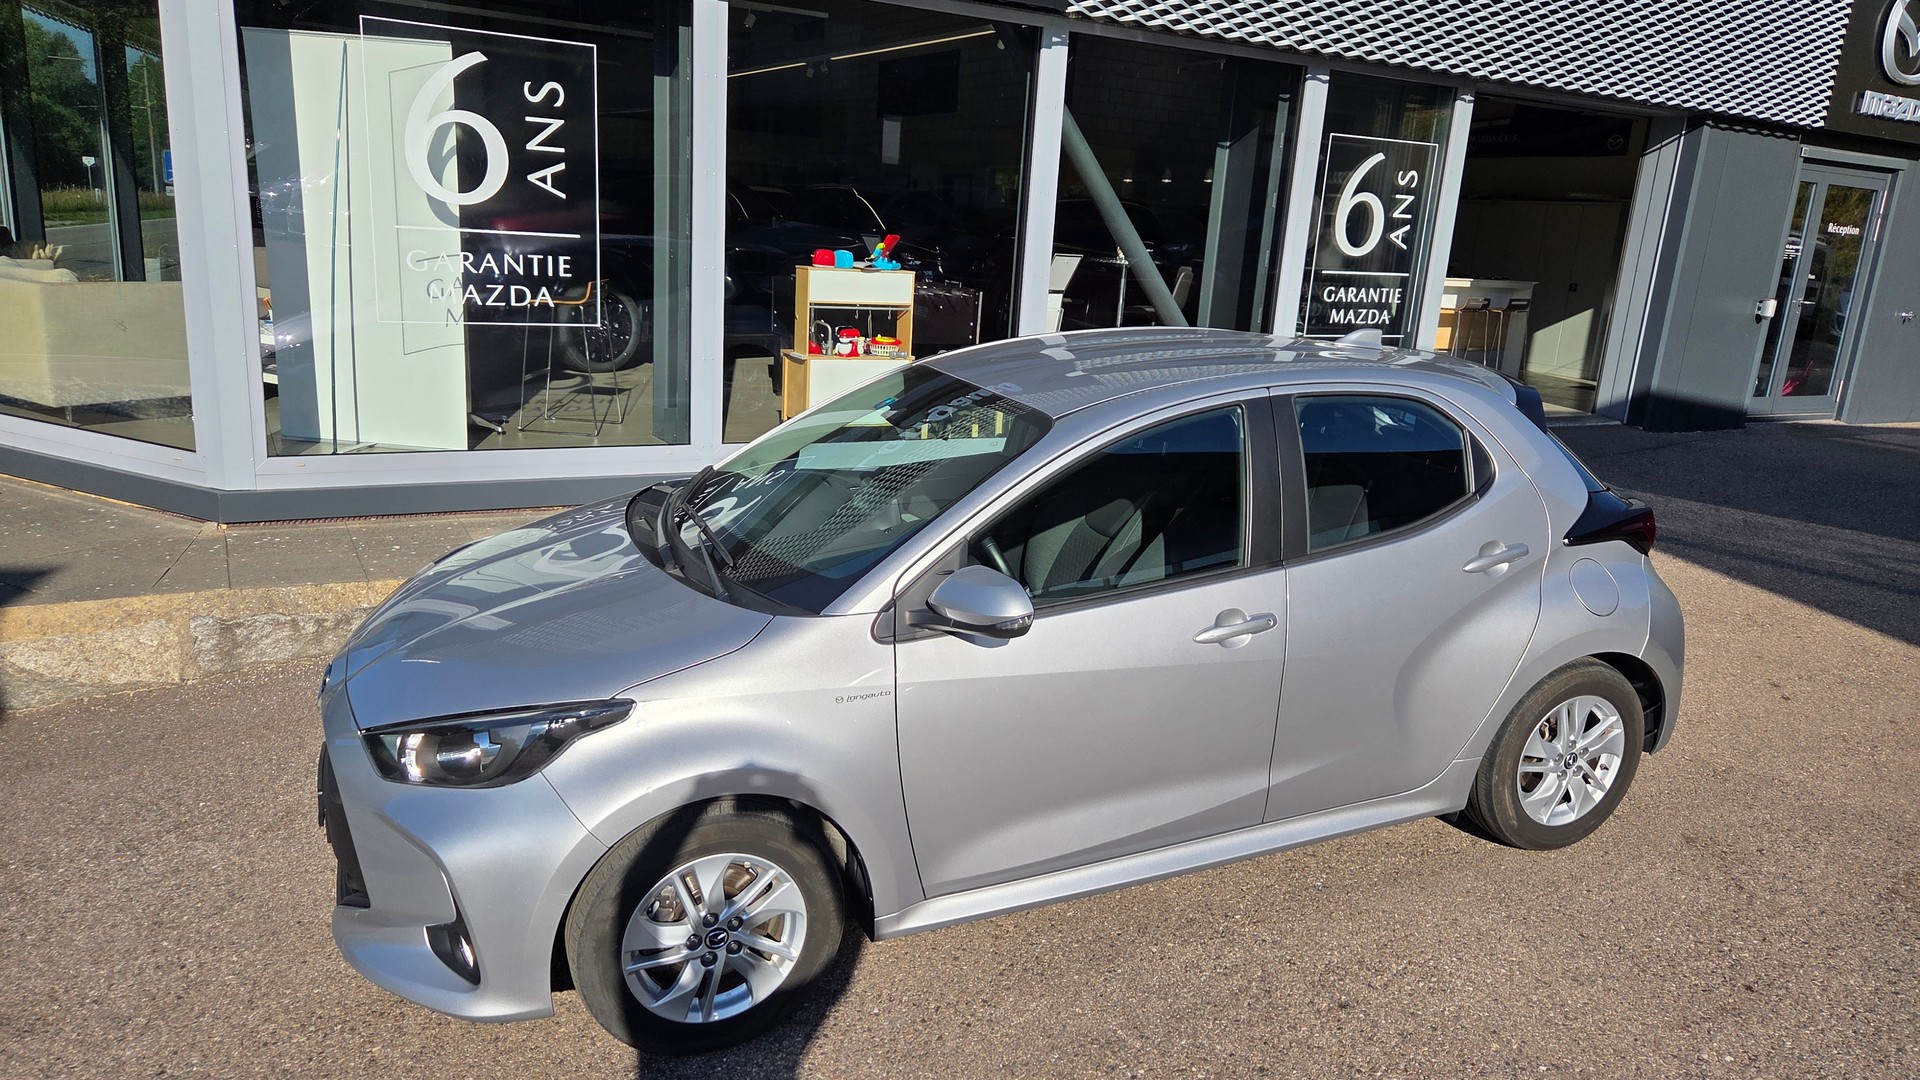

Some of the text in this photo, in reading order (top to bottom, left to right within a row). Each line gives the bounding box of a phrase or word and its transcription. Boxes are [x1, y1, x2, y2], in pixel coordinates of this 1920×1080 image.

[405, 51, 566, 205] 6 ANS
[1335, 152, 1418, 257] 6 ANS
[1827, 222, 1860, 236] Réception
[406, 250, 573, 278] GARANTIE
[430, 283, 555, 308] MAZDA
[1323, 286, 1403, 304] GARANTIE
[1329, 308, 1391, 325] MAZDA
